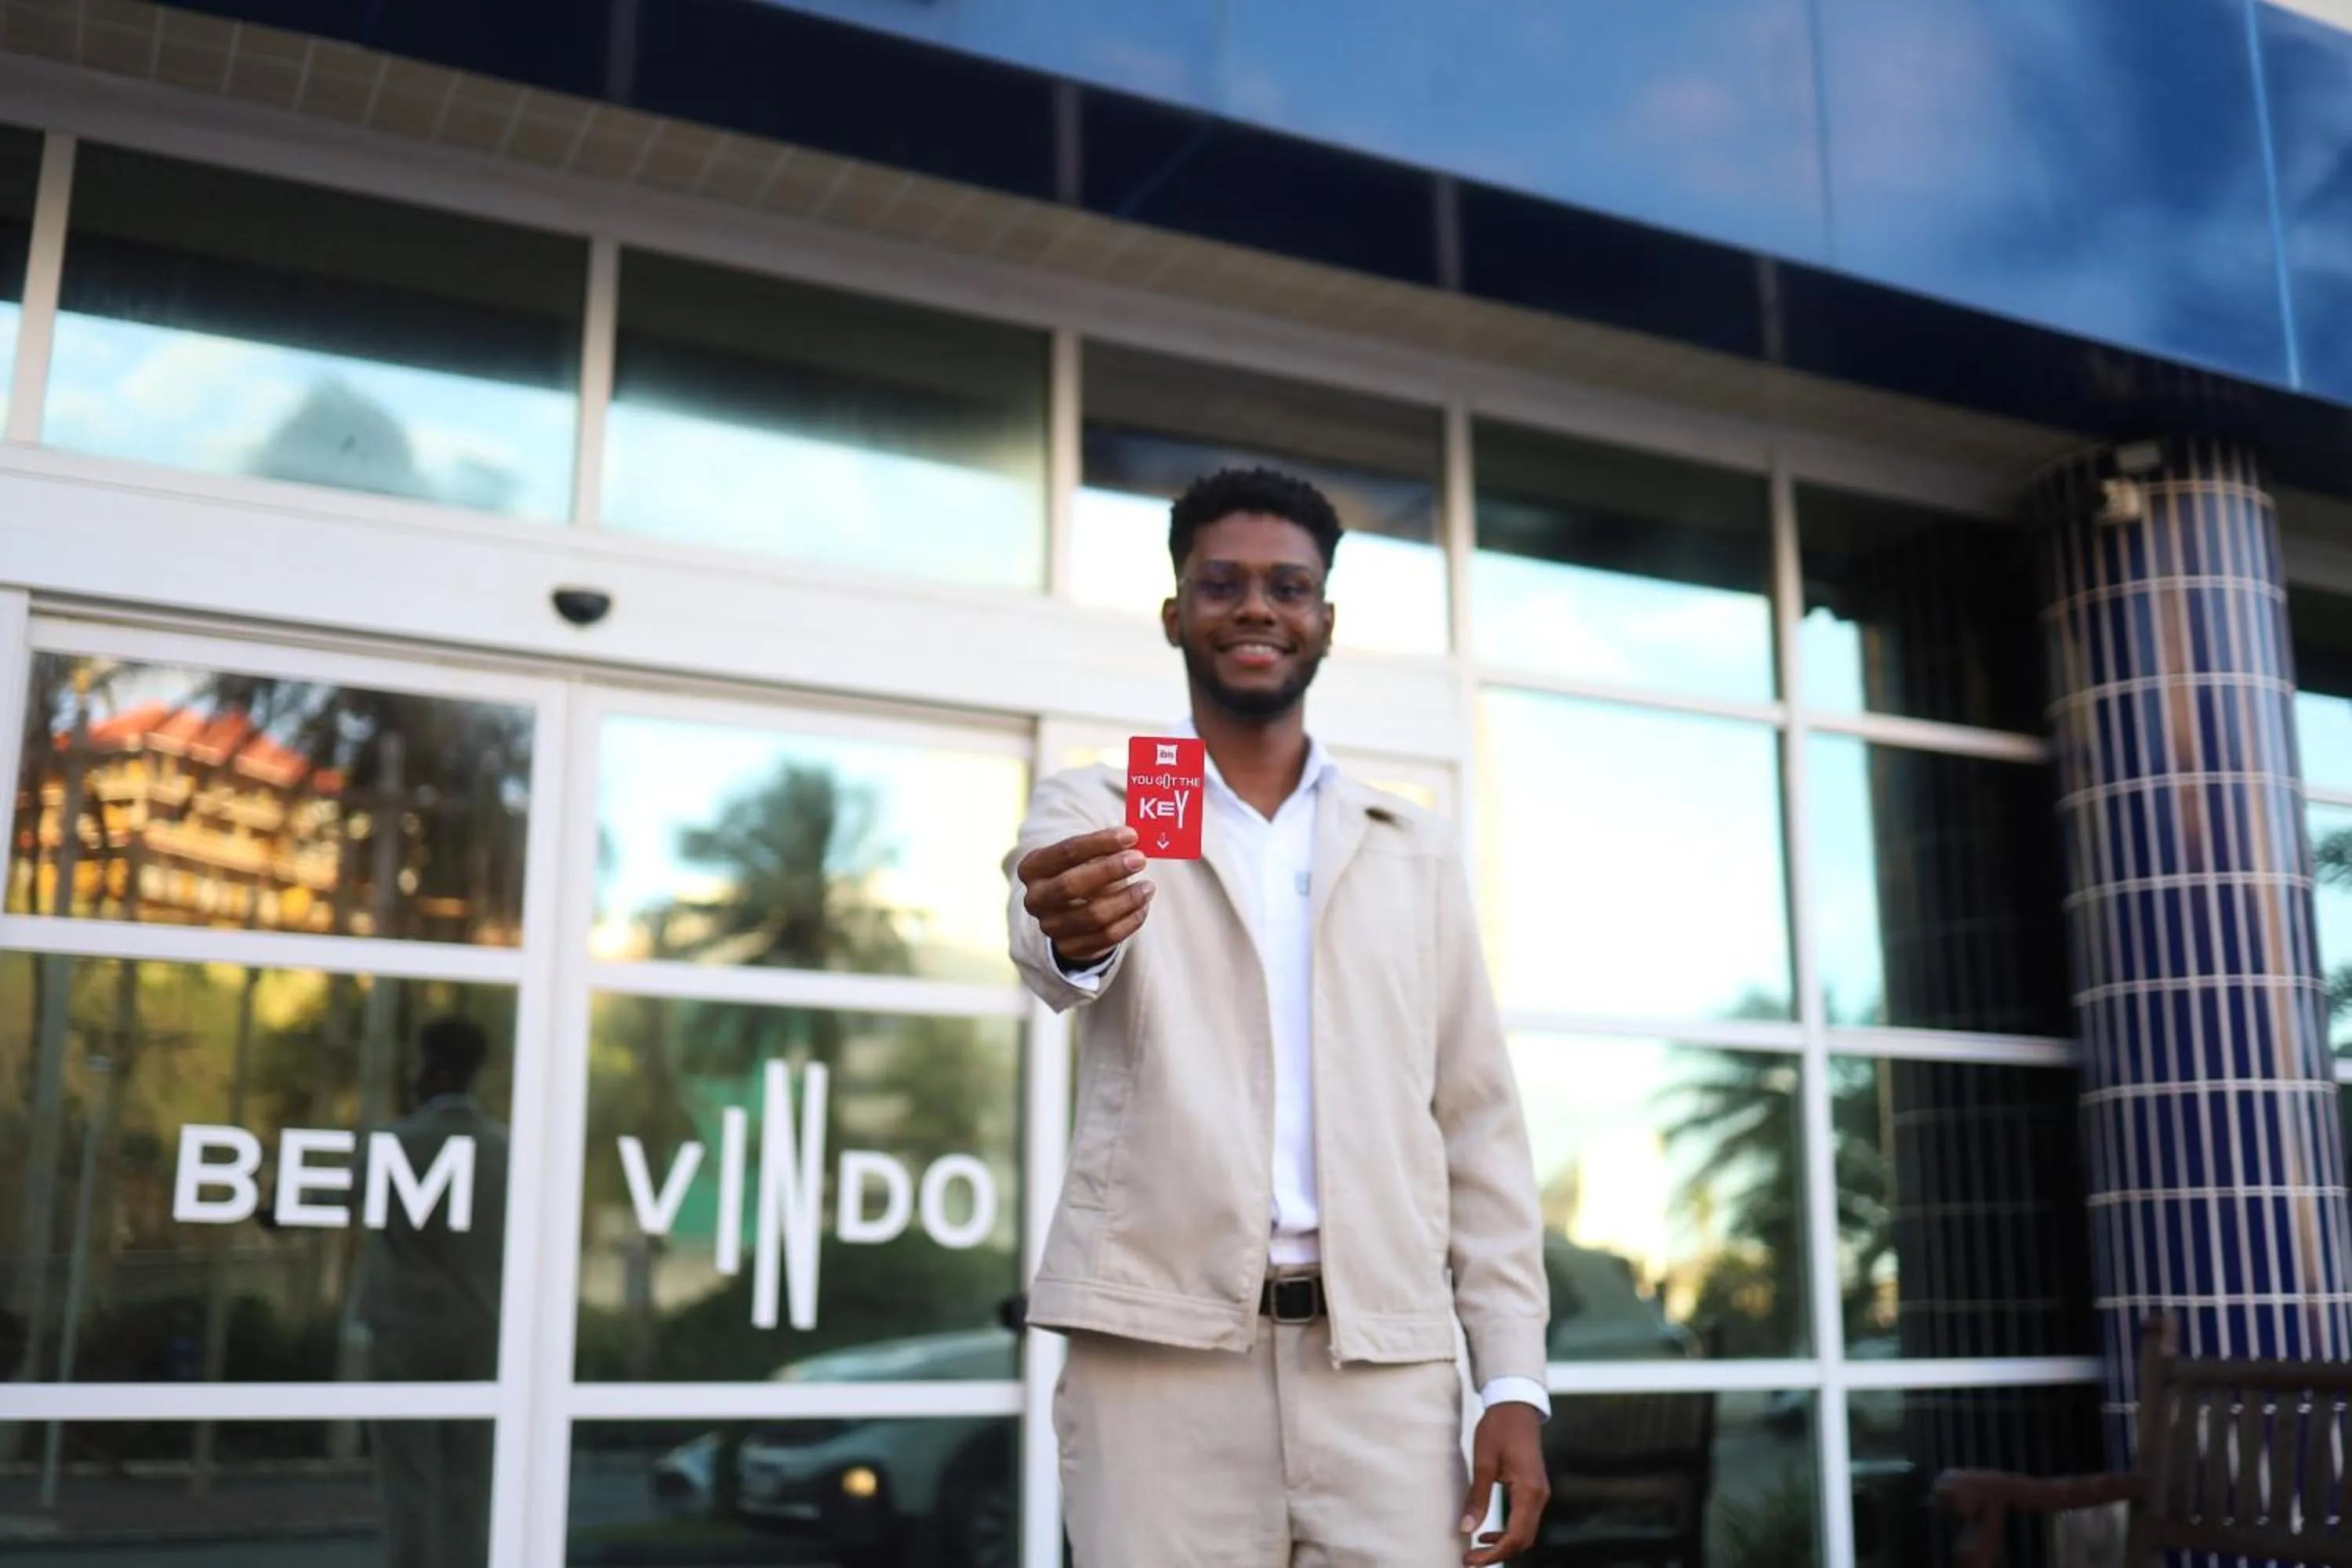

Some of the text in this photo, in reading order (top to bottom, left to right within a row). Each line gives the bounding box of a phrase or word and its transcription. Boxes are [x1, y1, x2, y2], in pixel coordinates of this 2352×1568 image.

[1131, 773, 1200, 789] YOU GOT THE
[1139, 790, 1189, 829] KEY
[172, 1058, 996, 1330] BEM VINDO
